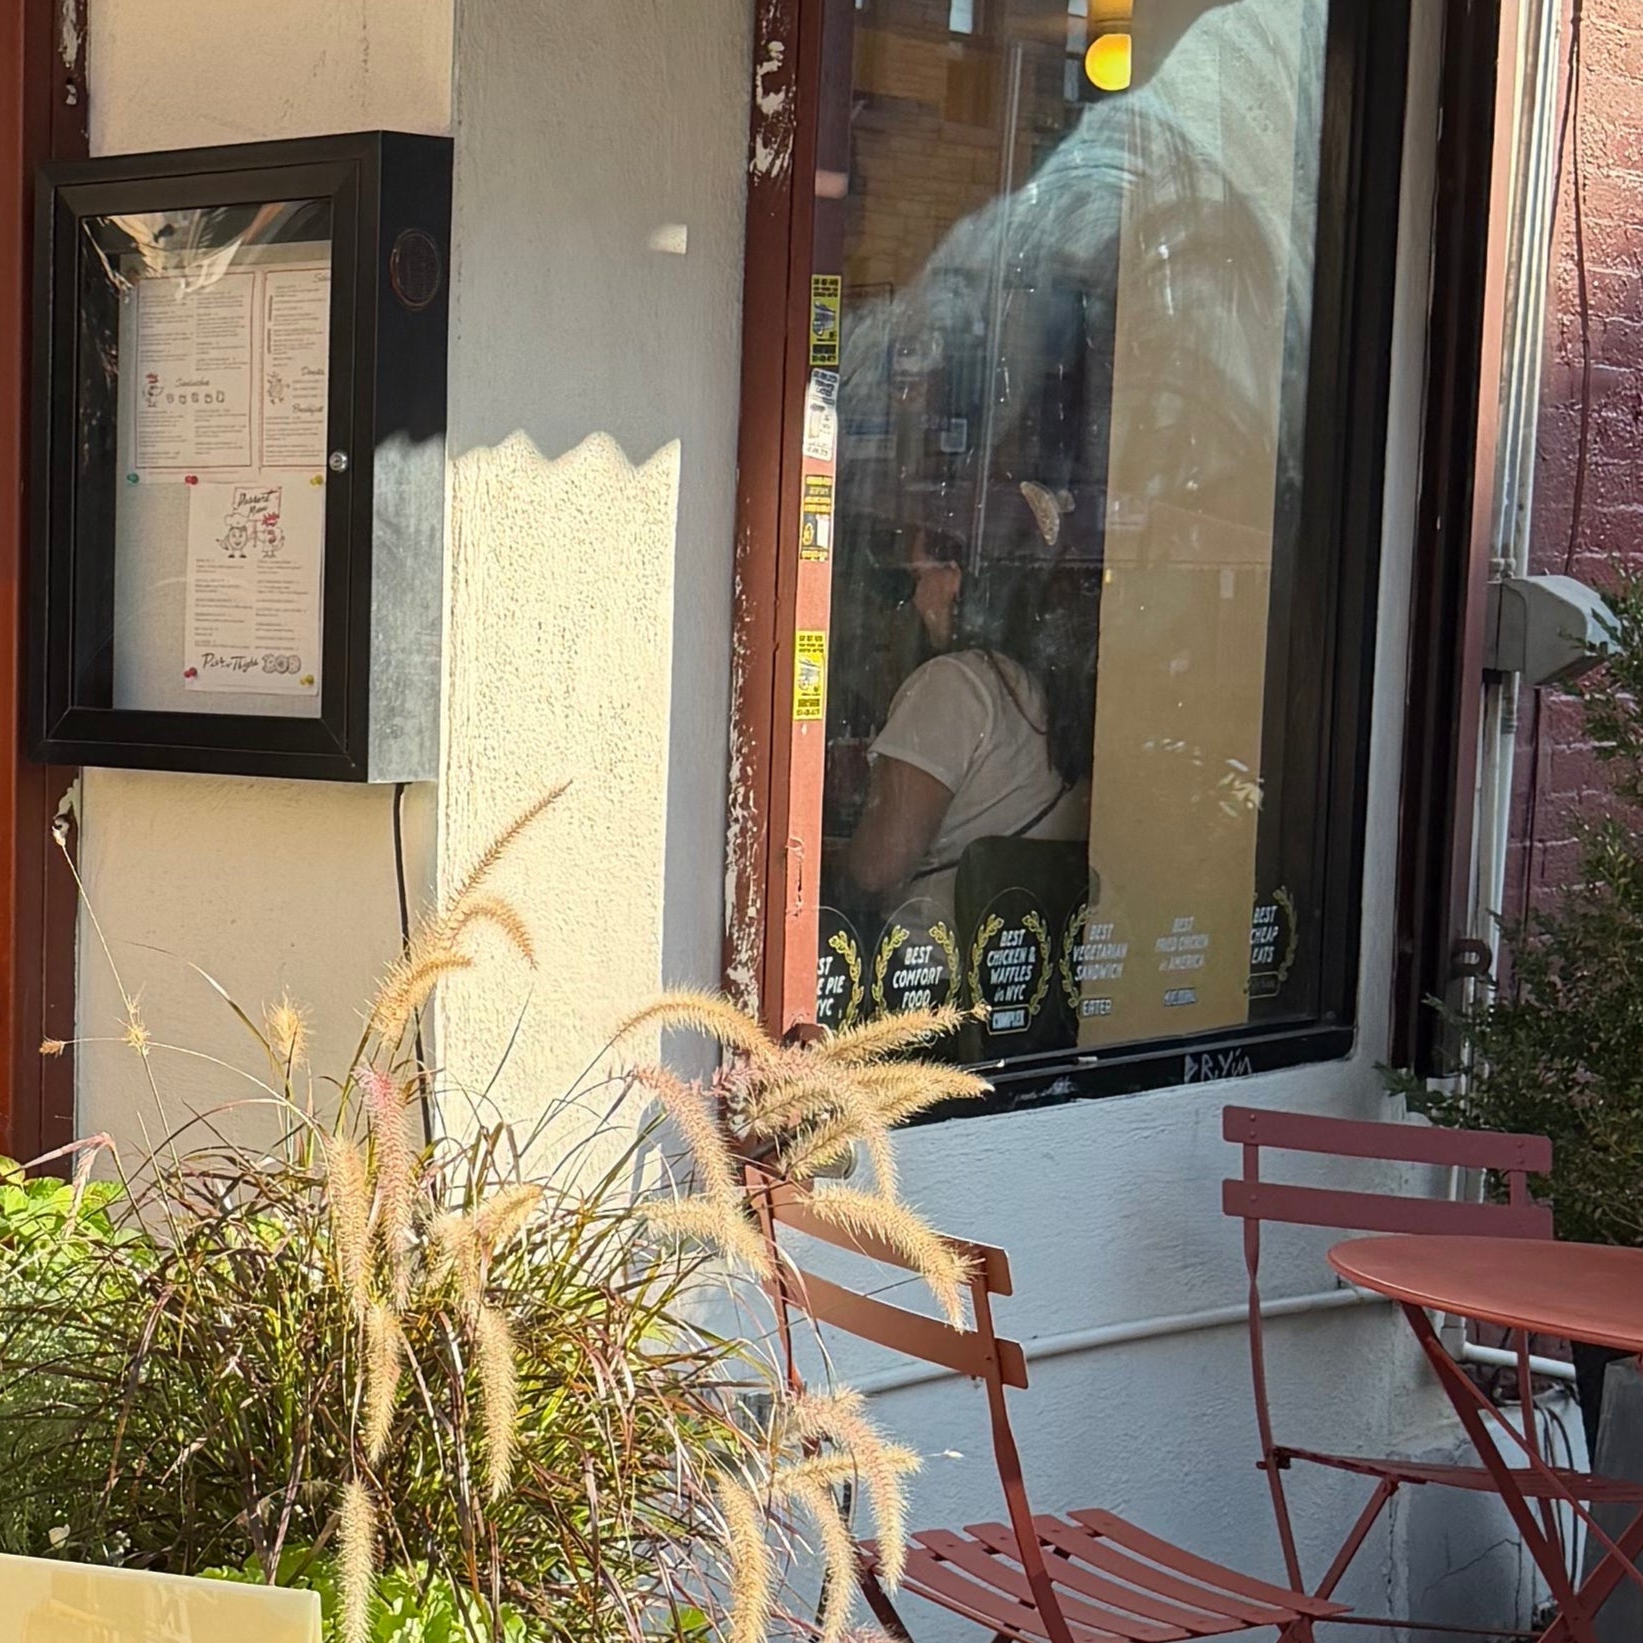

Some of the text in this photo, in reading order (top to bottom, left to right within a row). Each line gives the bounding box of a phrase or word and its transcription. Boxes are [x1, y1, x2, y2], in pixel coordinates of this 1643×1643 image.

[1253, 906, 1278, 924] BEST
[999, 929, 1026, 947] BEST
[1089, 923, 1114, 941] BEST
[1250, 926, 1279, 945] CHEAP
[904, 945, 934, 966] BEST
[986, 946, 1028, 967] CHICKEN
[1073, 943, 1129, 963] VEGETARIAN
[1251, 946, 1275, 964] EATS
[817, 956, 834, 975] ST
[990, 965, 1033, 985] WAFFLES
[1074, 963, 1125, 982] SANDWICH
[825, 975, 846, 995] PIE
[892, 966, 944, 989] COMFORT
[902, 989, 931, 1009] FOOD
[994, 984, 1027, 1002] in NYC
[817, 998, 834, 1017] YC
[1082, 999, 1113, 1016] EATER
